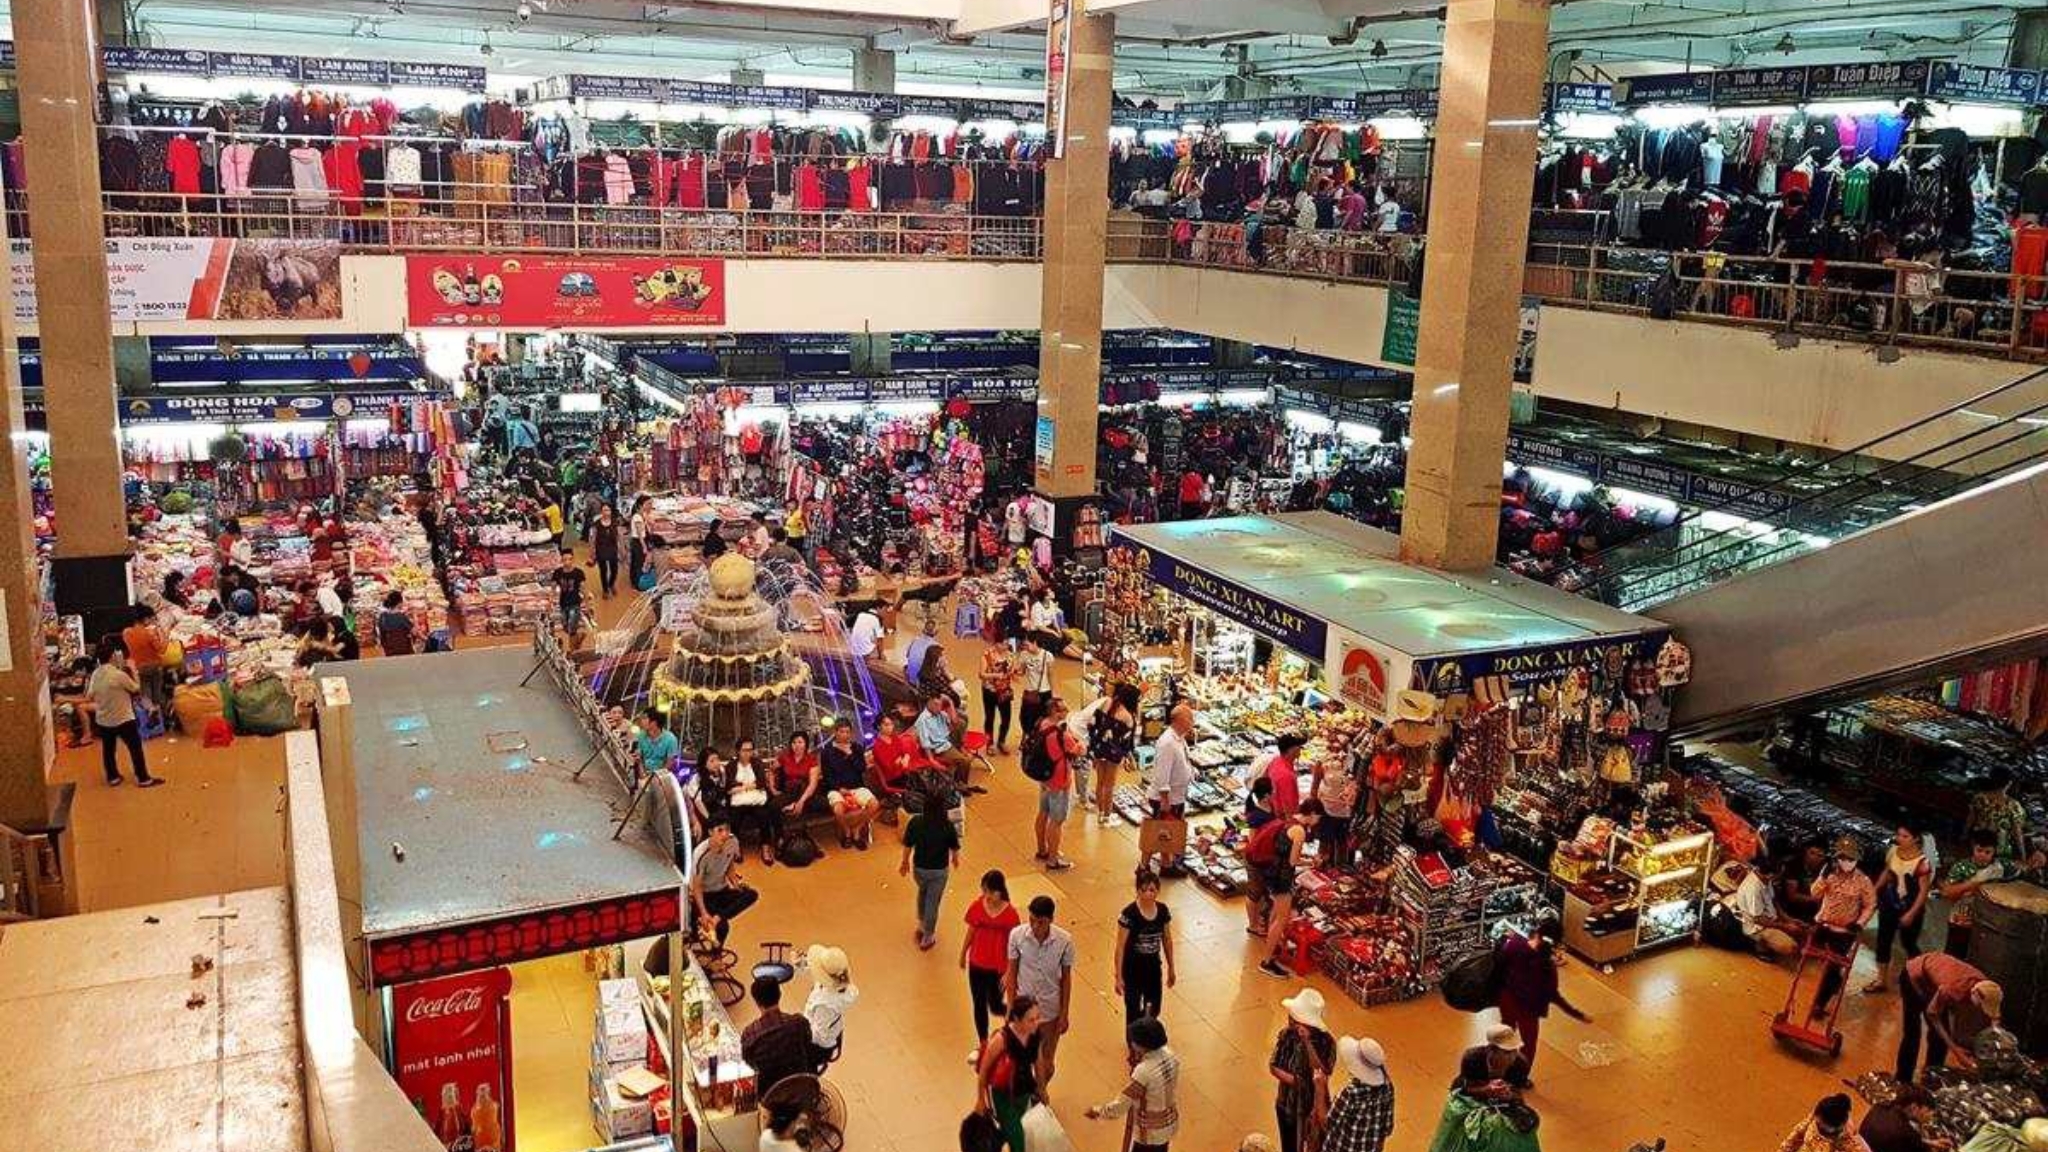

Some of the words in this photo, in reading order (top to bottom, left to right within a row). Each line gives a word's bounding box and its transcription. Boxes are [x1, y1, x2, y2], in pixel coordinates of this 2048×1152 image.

[1174, 564, 1218, 594] DONG
[1221, 586, 1267, 615] XUAN
[1269, 606, 1306, 634] ART
[1252, 615, 1288, 636] Shop
[406, 986, 485, 1022] Coca-Cola
